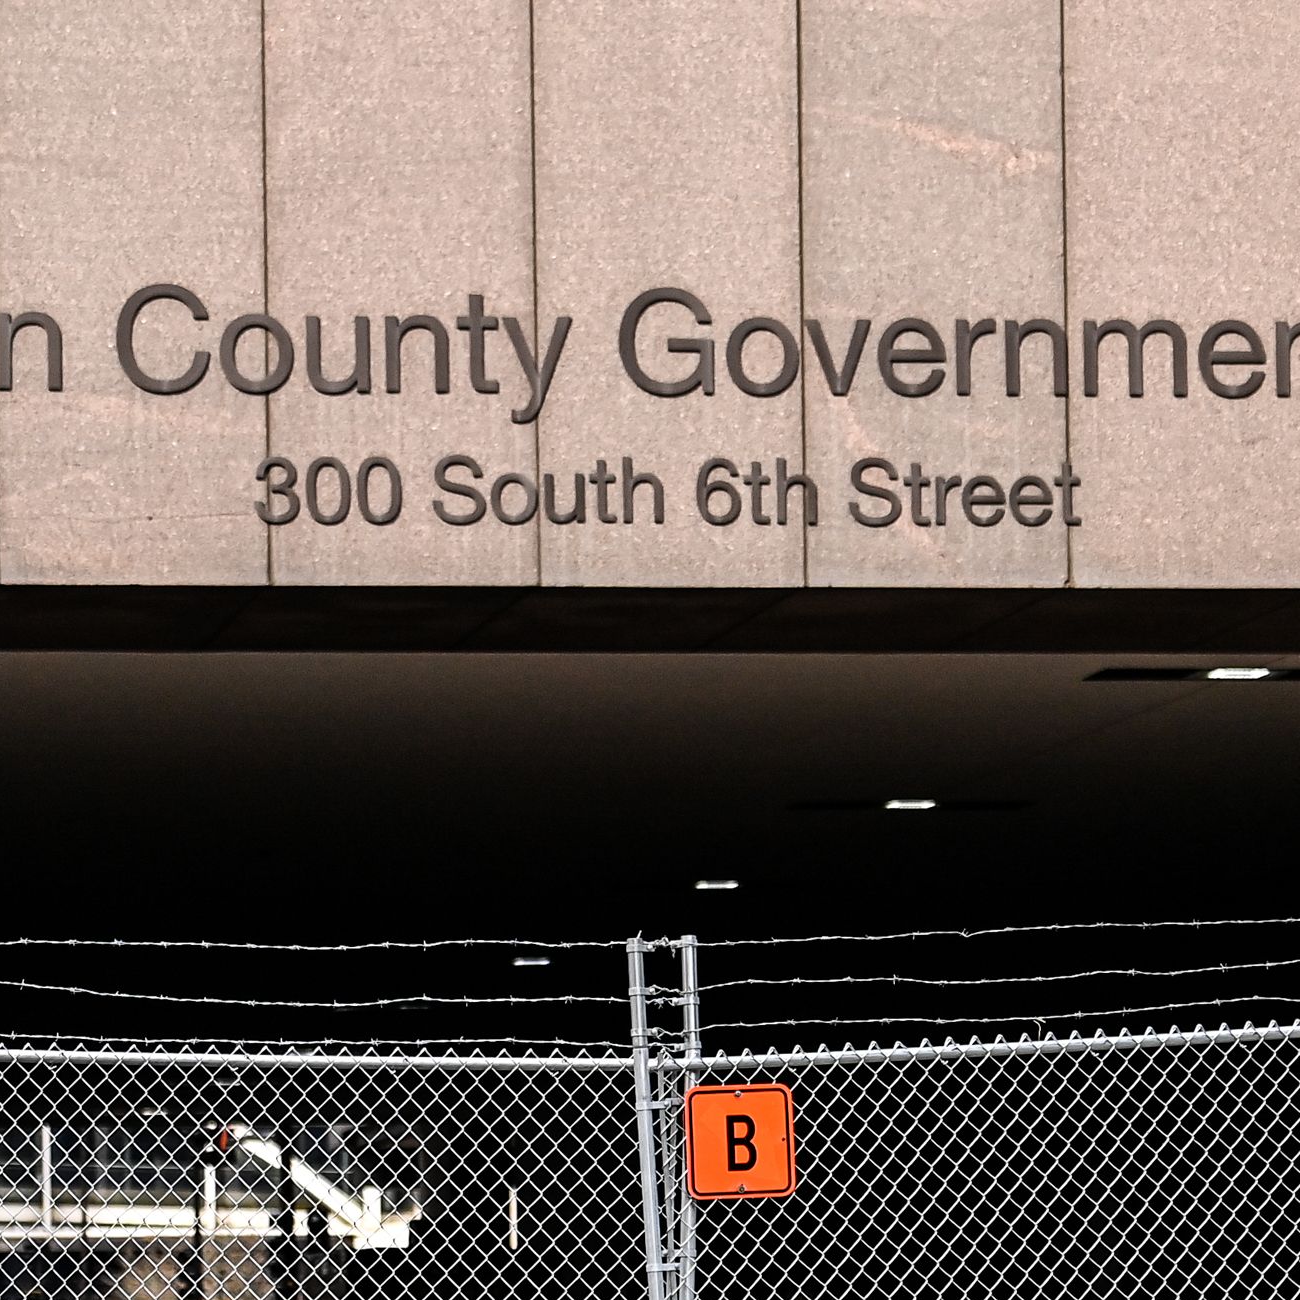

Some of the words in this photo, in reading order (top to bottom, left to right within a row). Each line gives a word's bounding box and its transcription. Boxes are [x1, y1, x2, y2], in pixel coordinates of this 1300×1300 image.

[115, 282, 573, 425] County
[252, 455, 403, 527] 300
[431, 454, 666, 527] South
[696, 456, 818, 527] 6th
[848, 456, 1082, 528] Street
[725, 1114, 758, 1172] B
